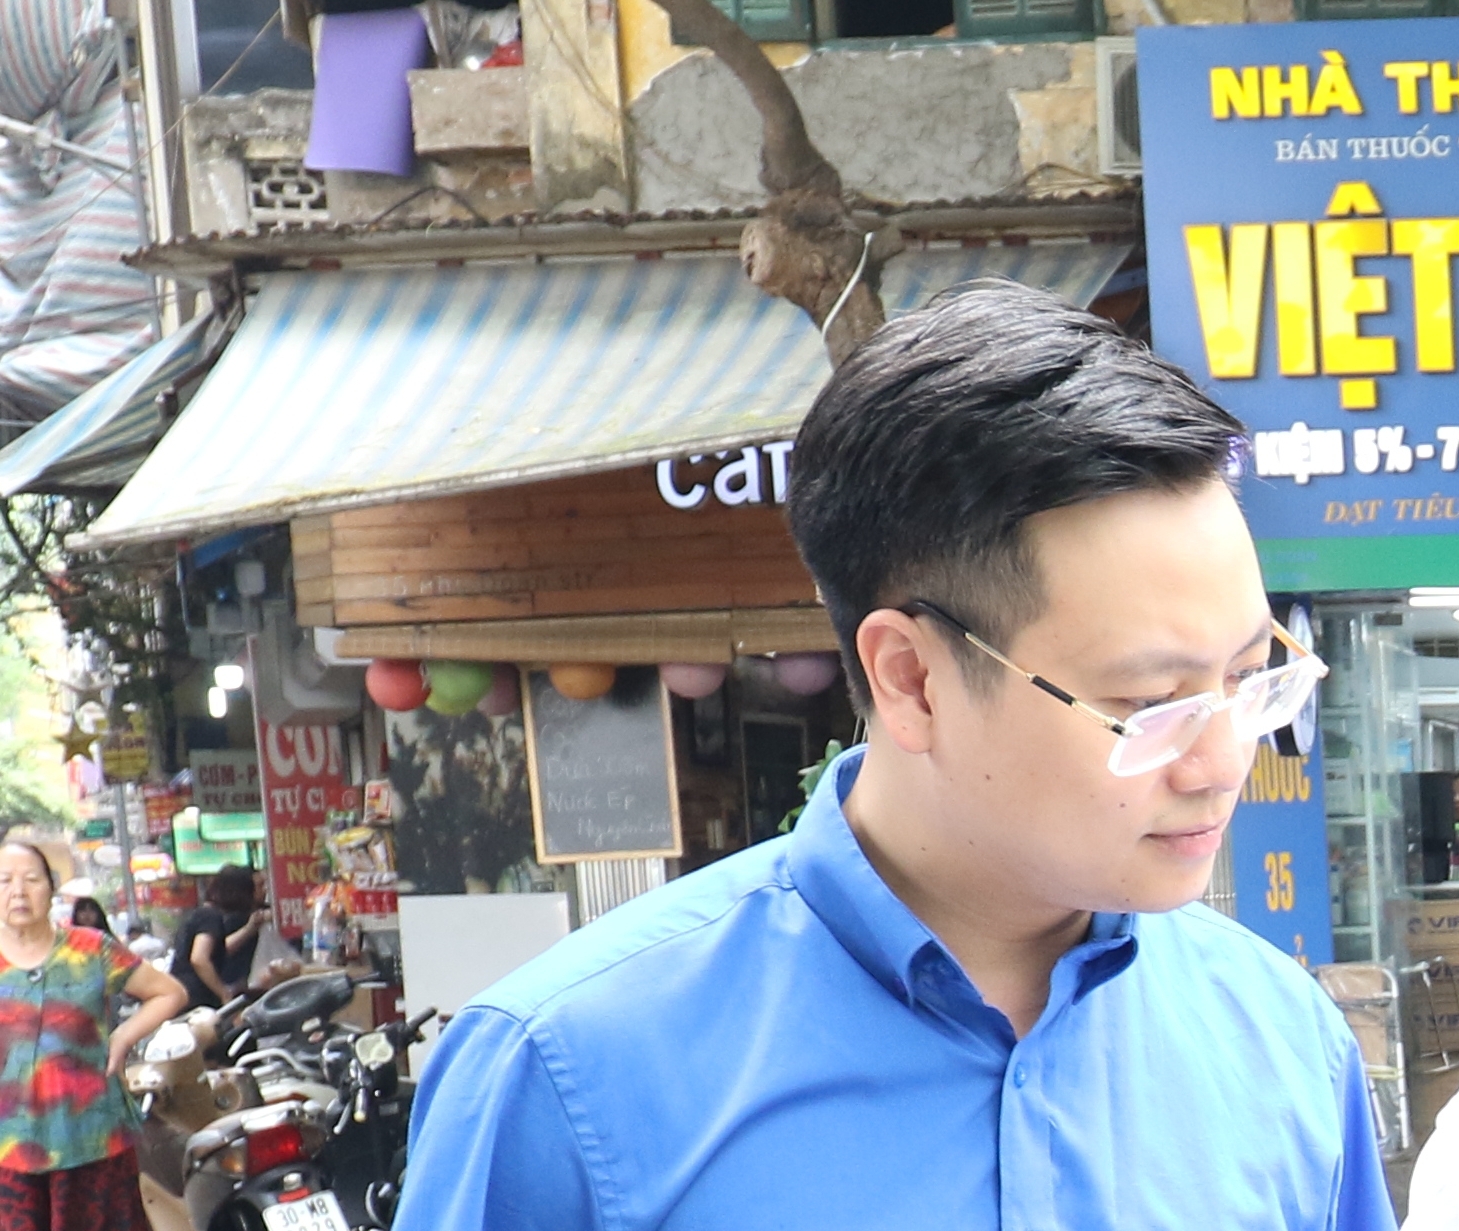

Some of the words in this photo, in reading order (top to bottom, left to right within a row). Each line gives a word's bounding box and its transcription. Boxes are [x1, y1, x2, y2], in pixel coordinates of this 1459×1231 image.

[1209, 49, 1363, 119] NHÀ
[1276, 131, 1339, 162] BÁN
[1347, 123, 1452, 160] THUỐC
[1255, 421, 1346, 484] KIỆM
[1322, 500, 1384, 527] ĐẠT
[1264, 851, 1295, 912] 35
